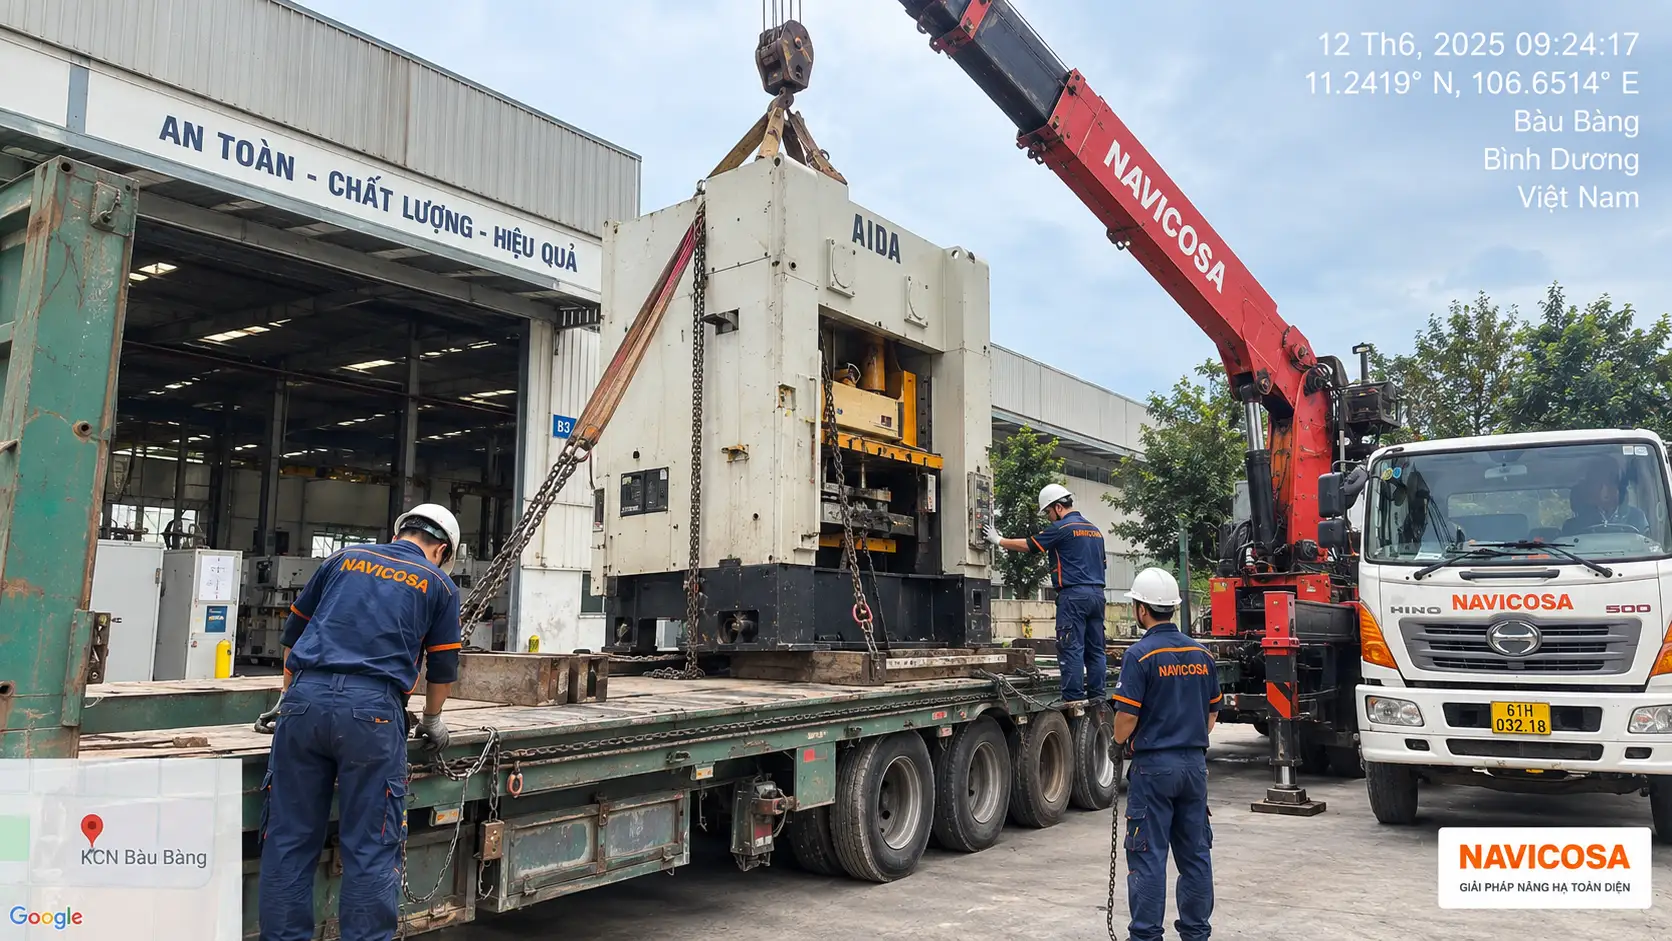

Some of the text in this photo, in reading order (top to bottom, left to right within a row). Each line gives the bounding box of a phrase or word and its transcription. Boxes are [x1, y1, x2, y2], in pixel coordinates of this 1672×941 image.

[159, 115, 204, 152] AN
[217, 131, 295, 181] TOÀN
[328, 170, 393, 213] CHẤT
[402, 195, 473, 239] LƯỢNG
[493, 225, 535, 259] HIỆU
[541, 242, 578, 273] QUẢ
[1103, 139, 1226, 294] NAVICOSA
[852, 213, 901, 264] AIDA
[557, 420, 570, 434] B3
[340, 558, 429, 594] NAVICOSA
[1452, 593, 1574, 611] NAVICOSA
[1606, 604, 1652, 614] 500
[1390, 606, 1442, 615] HINO
[1159, 664, 1209, 677] NAVICOSA
[1507, 703, 1534, 718] 61H
[1496, 718, 1546, 734] 032.18
